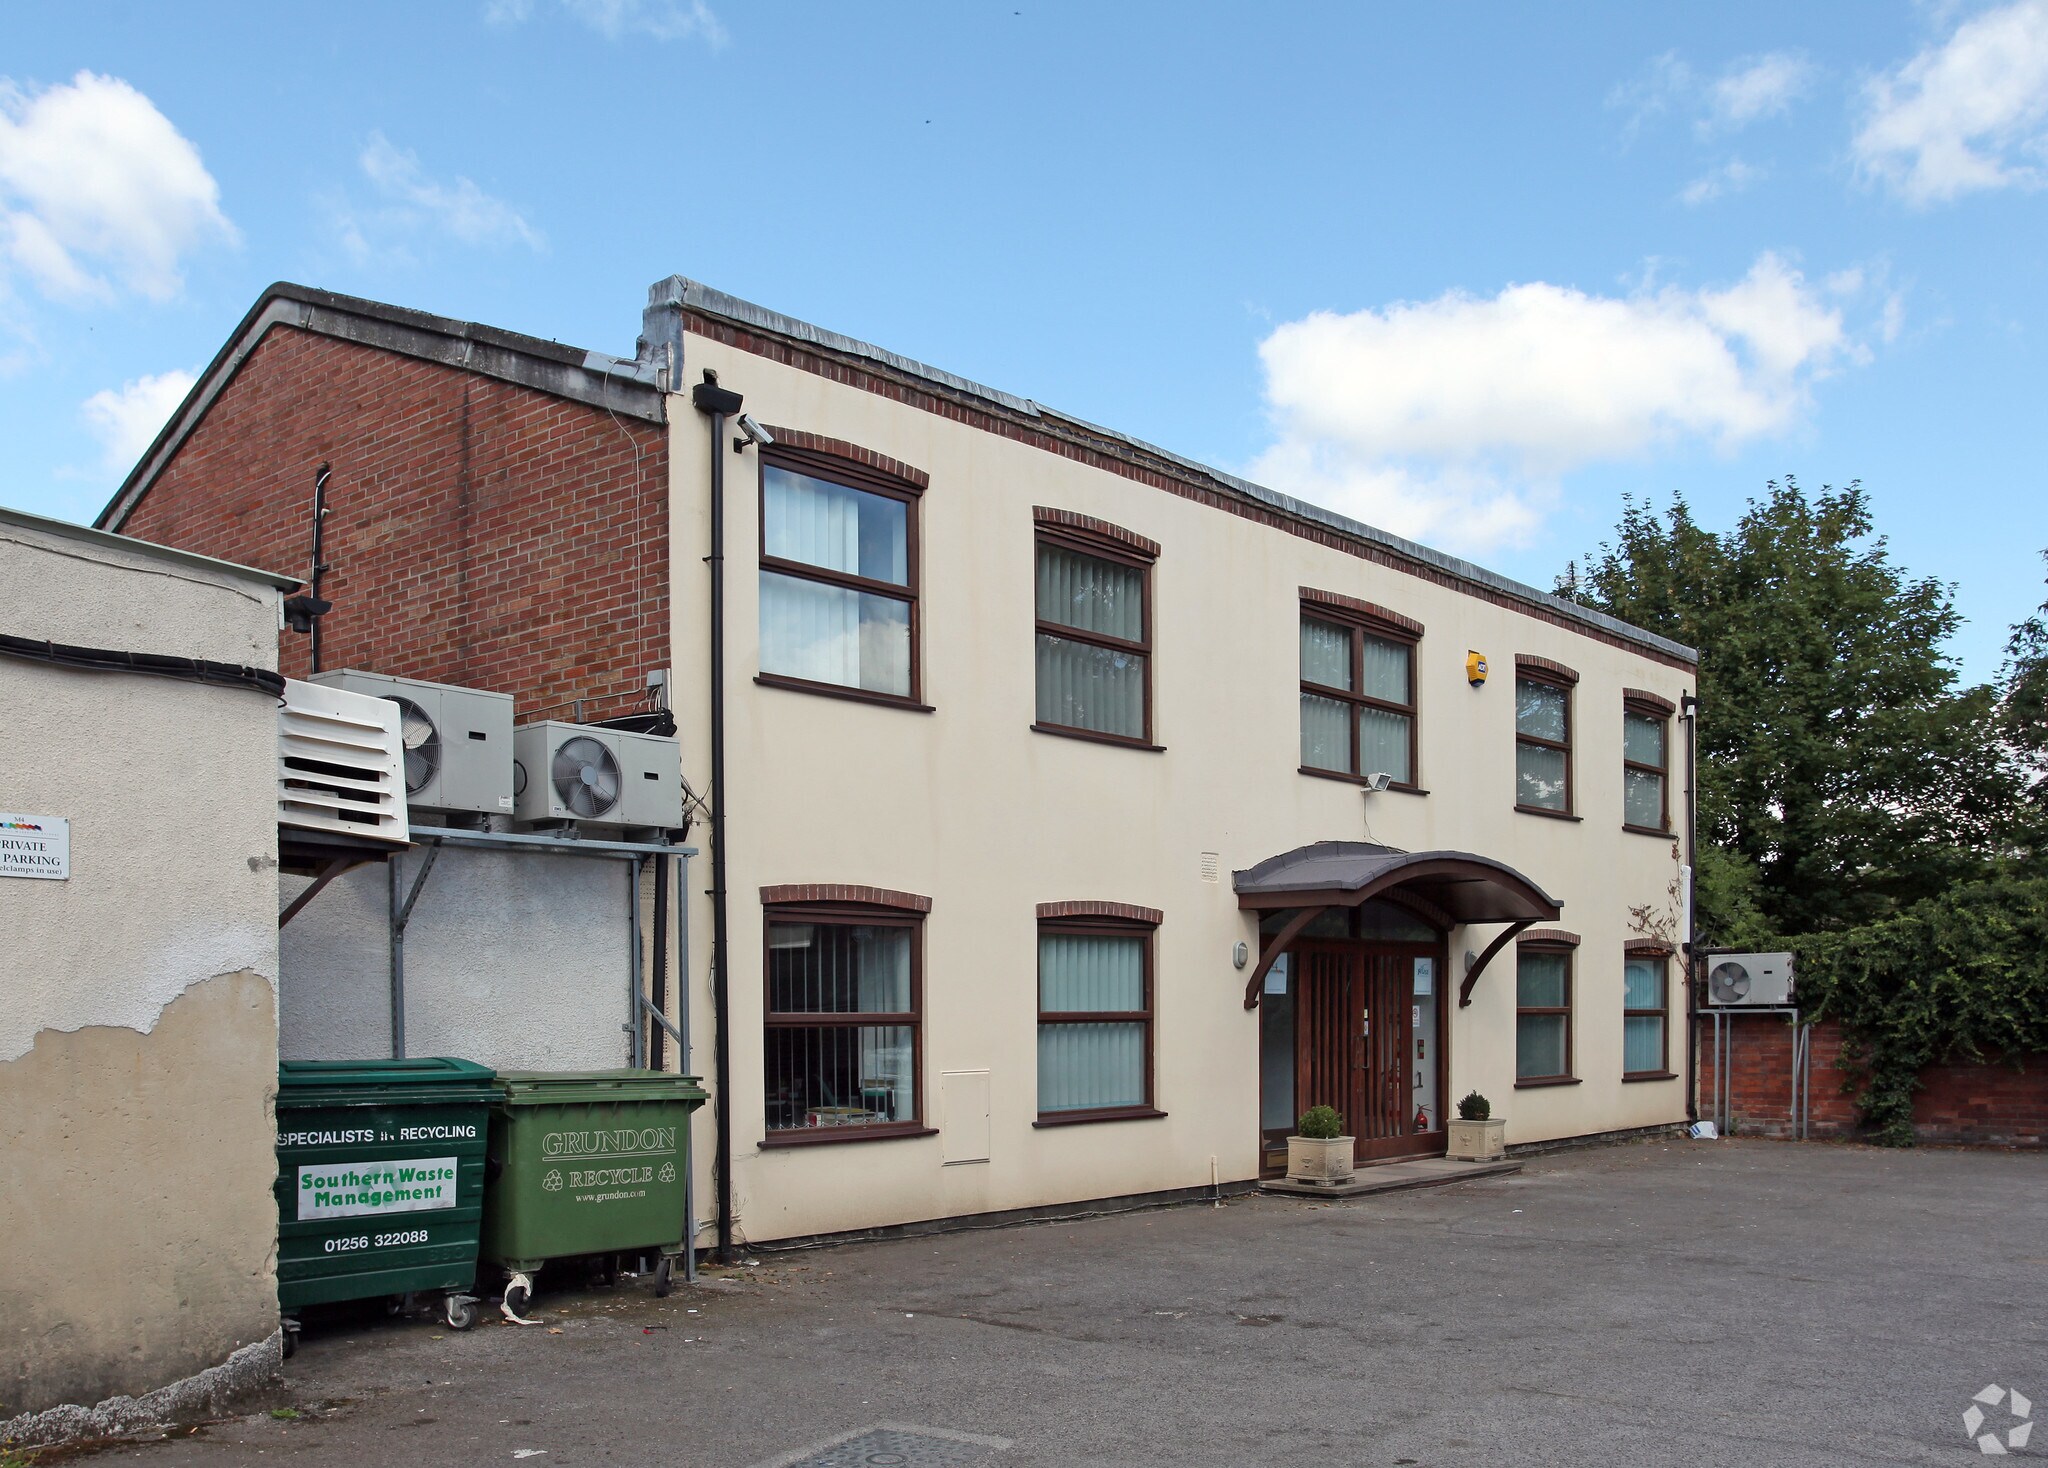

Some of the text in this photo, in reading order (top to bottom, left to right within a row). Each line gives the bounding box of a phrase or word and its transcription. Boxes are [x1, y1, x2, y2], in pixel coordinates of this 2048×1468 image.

[0, 840, 47, 852] RIVATE
[3, 853, 61, 866] PARKING
[36, 866, 45, 874] in
[277, 1129, 374, 1147] SPECIALISTS
[400, 1125, 477, 1141] RECYCLING
[542, 1127, 677, 1155] GRUNDON
[301, 1167, 455, 1190] Southern Waste
[569, 1166, 653, 1188] RECYCLE
[314, 1185, 442, 1209] Management
[575, 1189, 646, 1203] www.grundon.com
[324, 1229, 428, 1252] 01256 322088
